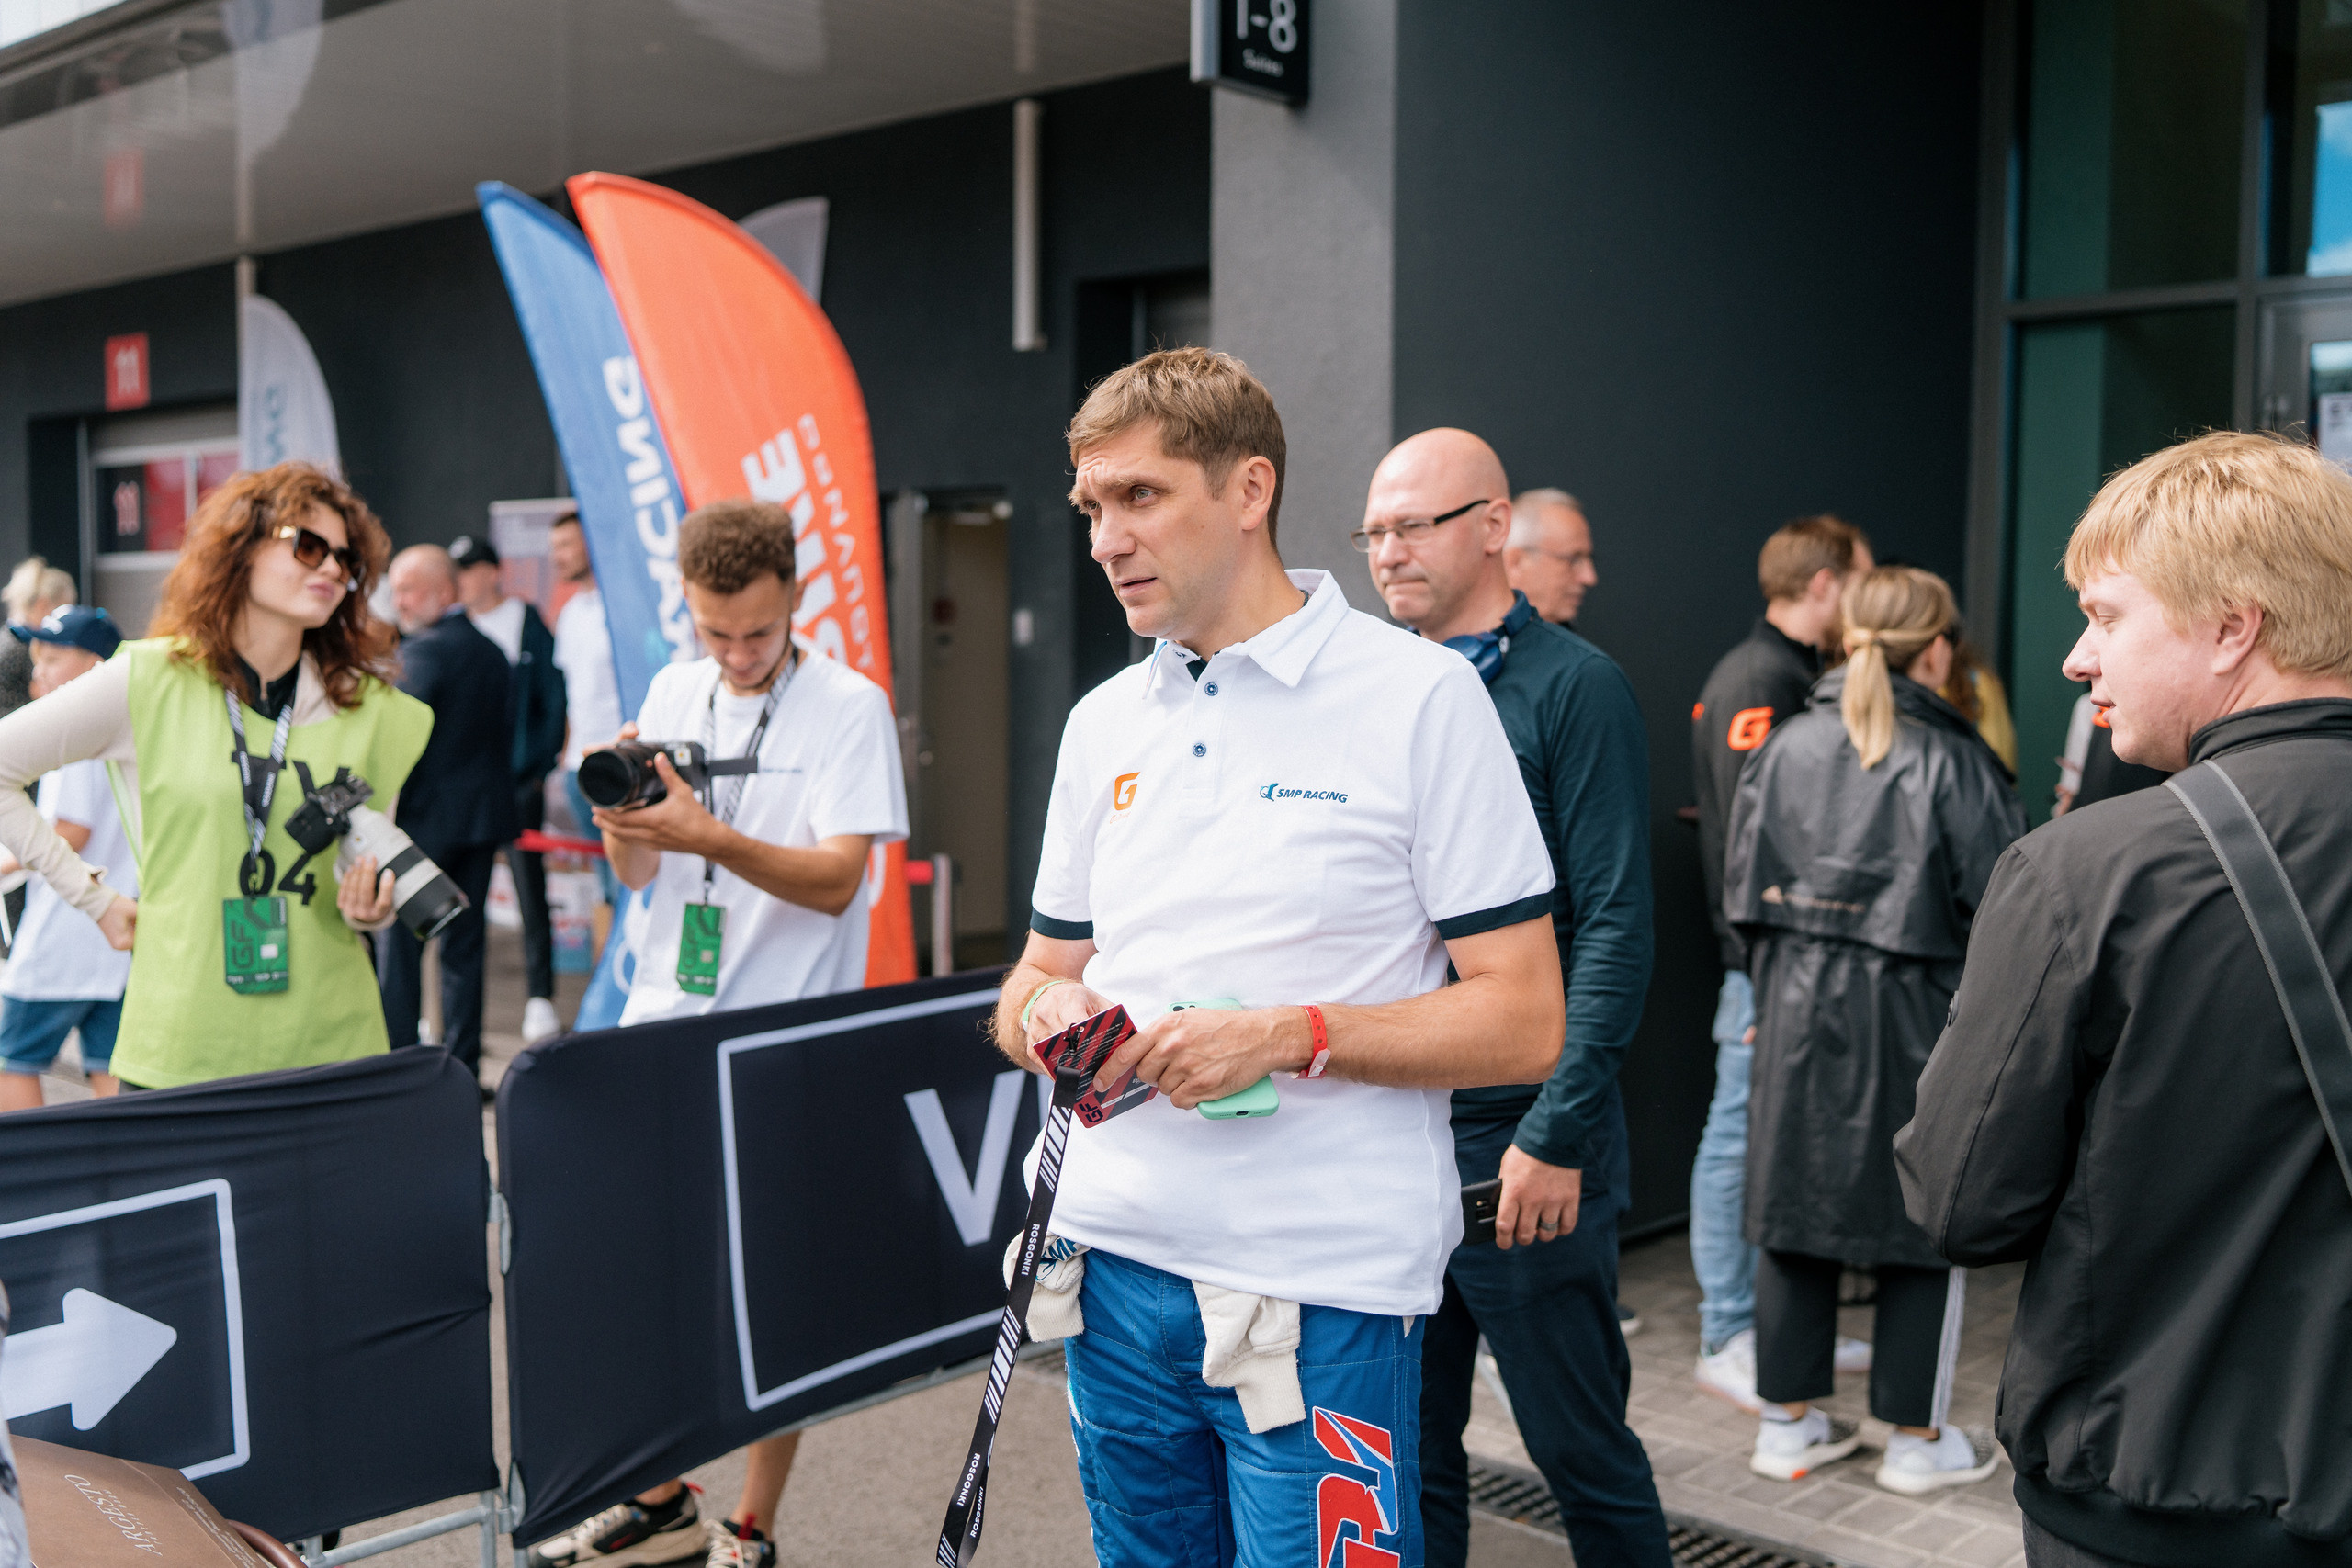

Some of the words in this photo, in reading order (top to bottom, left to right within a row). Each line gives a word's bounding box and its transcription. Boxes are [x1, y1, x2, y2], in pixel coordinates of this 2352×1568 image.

[1276, 788, 1303, 798] SMP
[1303, 790, 1349, 804] RACING
[1078, 1102, 1104, 1123] GF
[1021, 1223, 1041, 1276] ROSGONKI
[956, 1452, 981, 1507] ROSGONKI
[64, 1474, 163, 1556] ARGESTO
[970, 1486, 984, 1538] ROSGONKI
